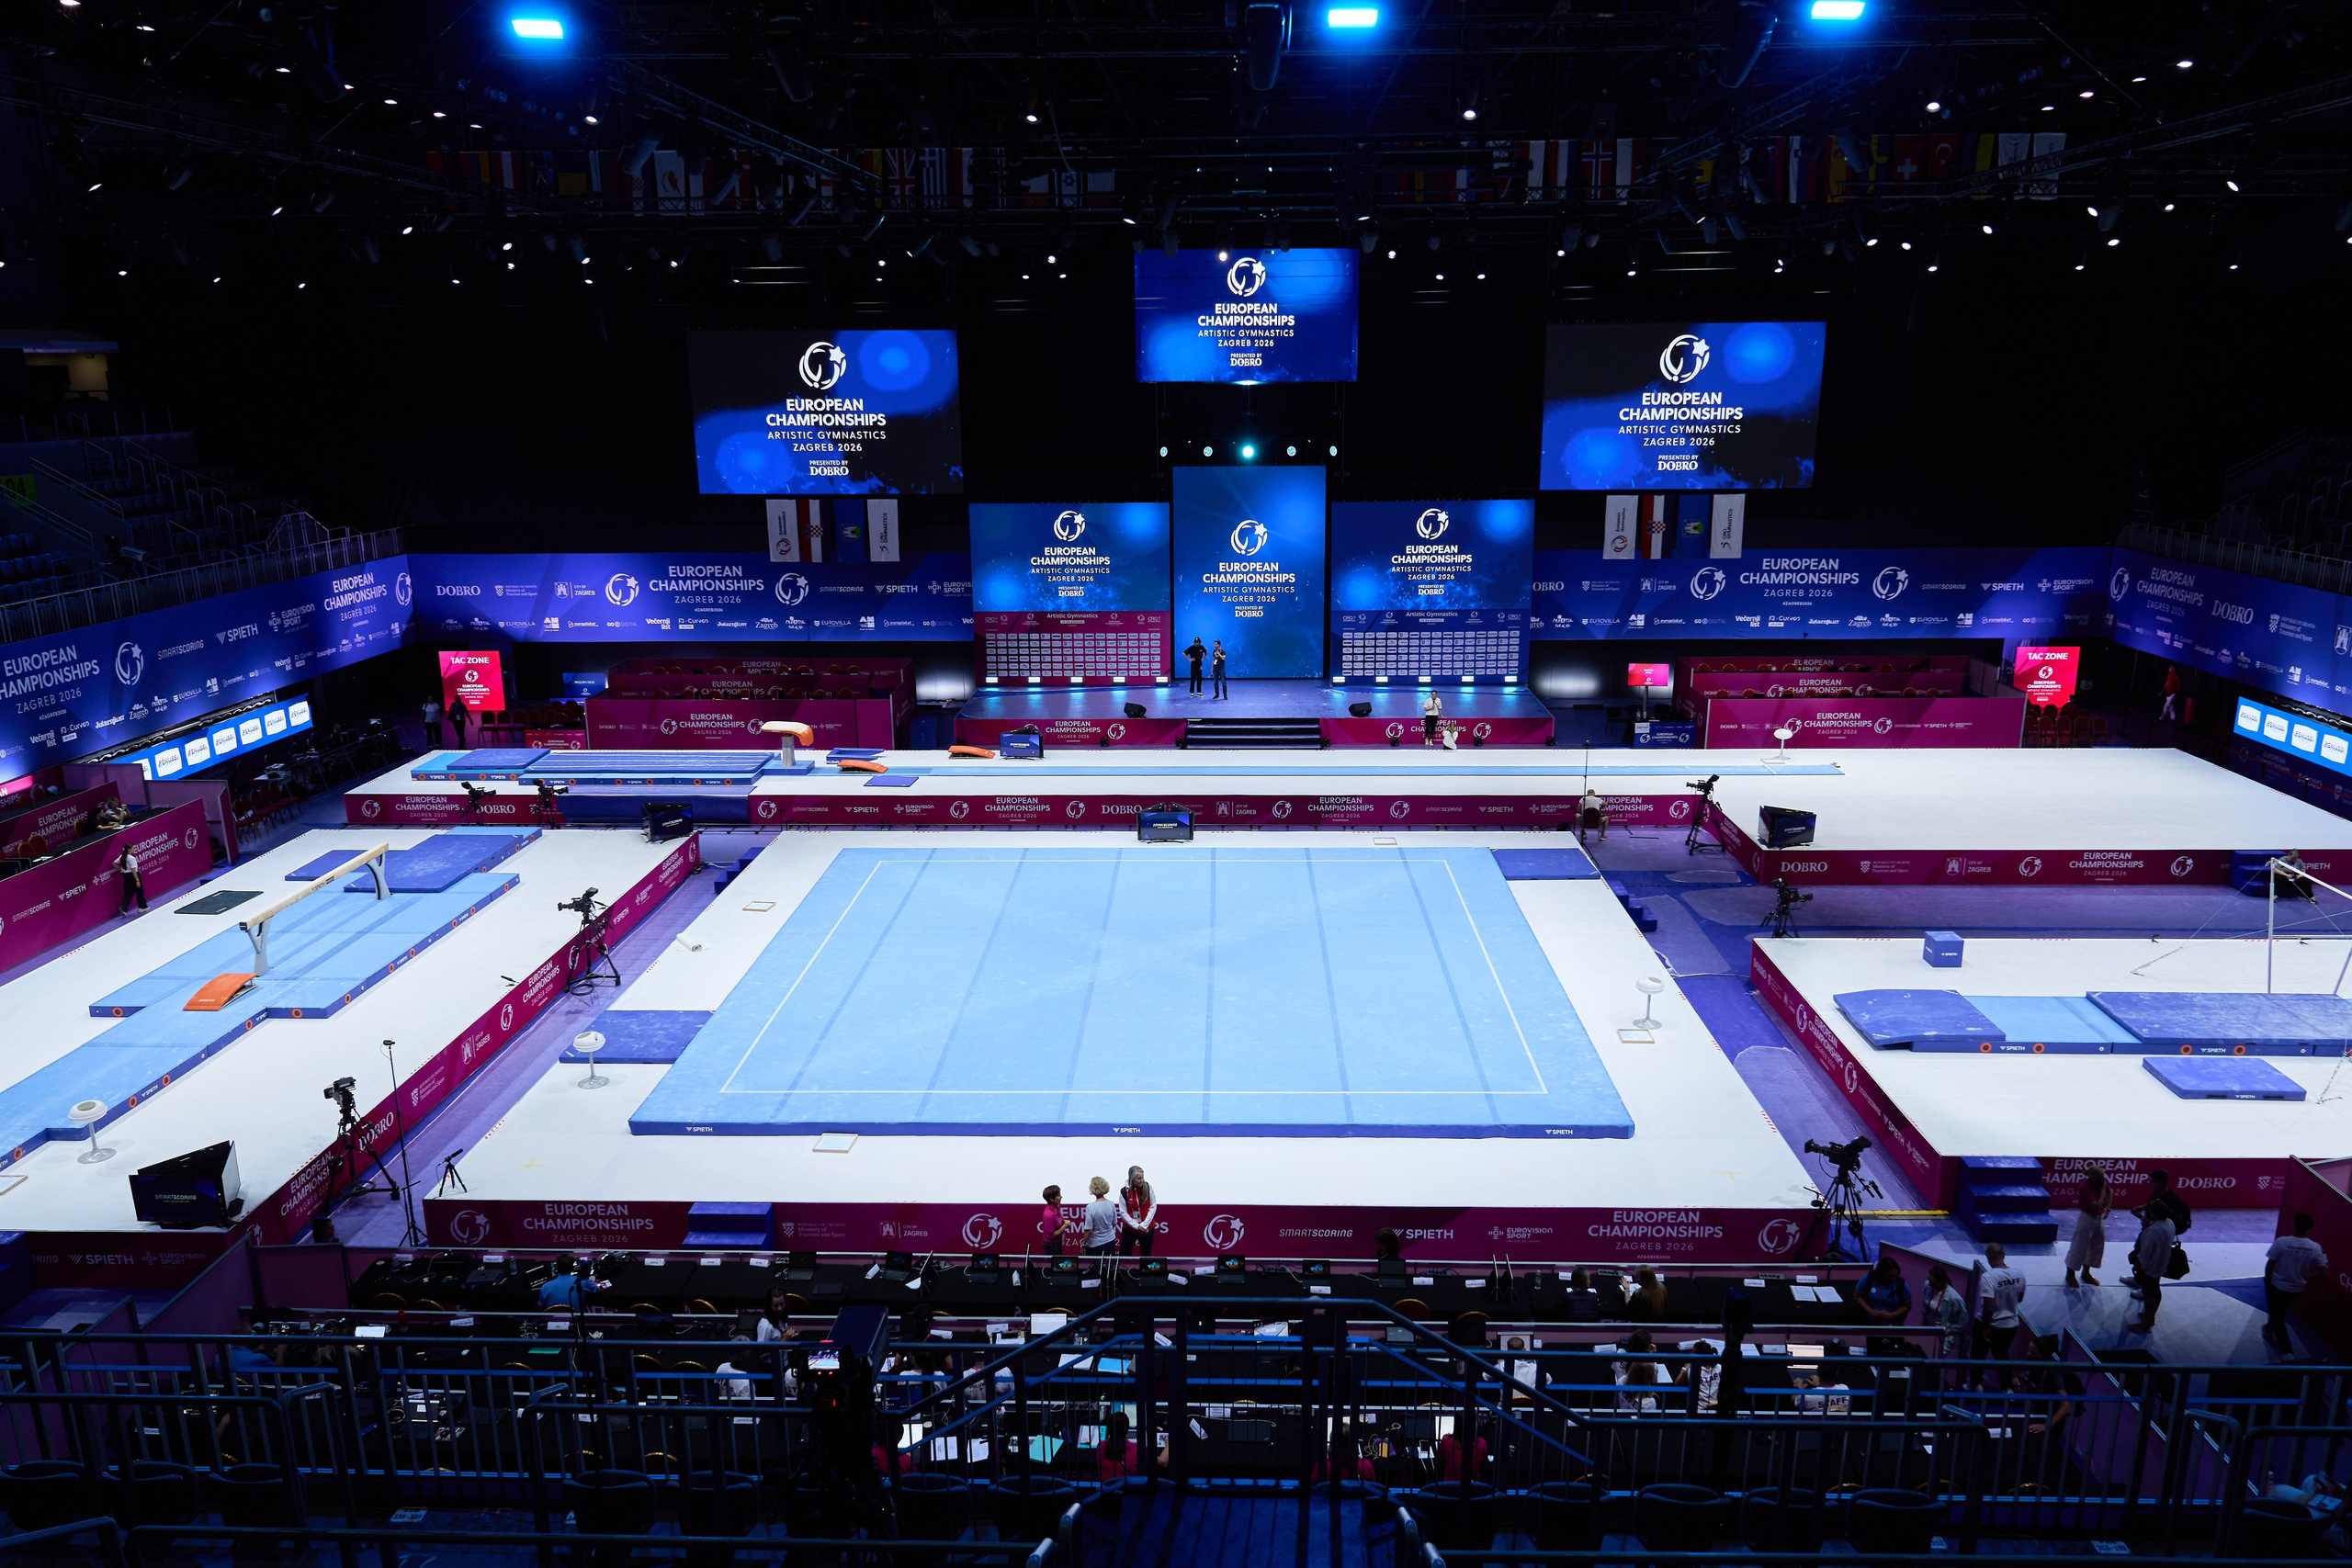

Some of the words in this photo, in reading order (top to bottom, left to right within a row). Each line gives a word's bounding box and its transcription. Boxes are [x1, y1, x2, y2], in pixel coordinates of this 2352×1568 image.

[1216, 303, 1277, 313] EUROPEAN
[1198, 316, 1295, 326] CHAMPIONSHIPS
[1230, 358, 1262, 367] DOBRO
[1642, 392, 1722, 405] EUROPEAN
[786, 399, 864, 411] EUROPEAN
[1619, 407, 1743, 421] CHAMPIONSHIPS
[766, 414, 886, 426] CHAMPIONSHIPS
[1670, 425, 1741, 434] GYMNASTICS
[1644, 438, 1686, 446] ZAGREB
[1657, 461, 1698, 470] DOBRO
[809, 467, 849, 476] DOBRO
[1406, 545, 1458, 554] EUROPEAN
[1031, 557, 1111, 565] CHAMPIONSHIPS
[1391, 555, 1472, 563] CHAMPIONSHIPS
[1762, 558, 1838, 570] EUROPEAN
[668, 566, 742, 577] EUROPEAN
[1219, 562, 1279, 571] EUROPEAN
[333, 572, 374, 592] EUROPEAN
[1203, 573, 1295, 582] CHAMPIONSHIPS
[1740, 572, 1860, 584] CHAMPIONSHIPS
[2151, 568, 2195, 587] EUROPEAN
[436, 586, 481, 596] DOBRO
[650, 580, 764, 592] CHAMPIONSHIPS
[887, 585, 918, 593] SPIETH
[324, 584, 387, 611] CHAMPIONSHIPS
[1764, 589, 1804, 597] ZAGREB
[1809, 589, 1833, 597] 2026
[2137, 581, 2204, 606] CHAMPIONSHIPS
[2211, 600, 2254, 625] DOBRO
[755, 621, 778, 630] Zagreb
[228, 624, 258, 642] SPIETH
[157, 640, 204, 660] SMARTSCORING
[4, 645, 77, 677] EUROPEAN
[17, 694, 56, 714] ZAGREB
[60, 688, 82, 704] 2026
[39, 709, 67, 720] #ZAGREB2026
[29, 730, 55, 745] Večernji
[46, 738, 57, 748] list
[1102, 805, 1142, 814] DOBRO
[39, 806, 76, 825] EUROPEAN
[1781, 862, 1827, 872] DOBRO
[66, 884, 86, 899] SPIETH
[13, 900, 51, 922] SMARTSCORING
[528, 961, 552, 987] EUROPEAN
[523, 965, 560, 1003] CHAMPIONSHIPS
[147, 1085, 158, 1095] SPIETH
[2177, 1178, 2236, 1189] DOBRO
[545, 1203, 628, 1216] EUROPEAN
[1613, 1211, 1700, 1223] EUROPEAN
[524, 1218, 653, 1230] CHAMPIONSHIPS
[1279, 1228, 1352, 1237] SMARTSCORING
[1406, 1228, 1453, 1240] SPIETH
[1588, 1225, 1723, 1237] CHAMPIONSHIPS
[553, 1235, 599, 1243] ZAGREB
[603, 1235, 628, 1243] 2026
[1616, 1242, 1661, 1250] ZAGREB
[86, 1255, 133, 1265] SPIETH
[1997, 1277, 2020, 1288] STAFF
[1818, 1397, 1847, 1408] STAFF
